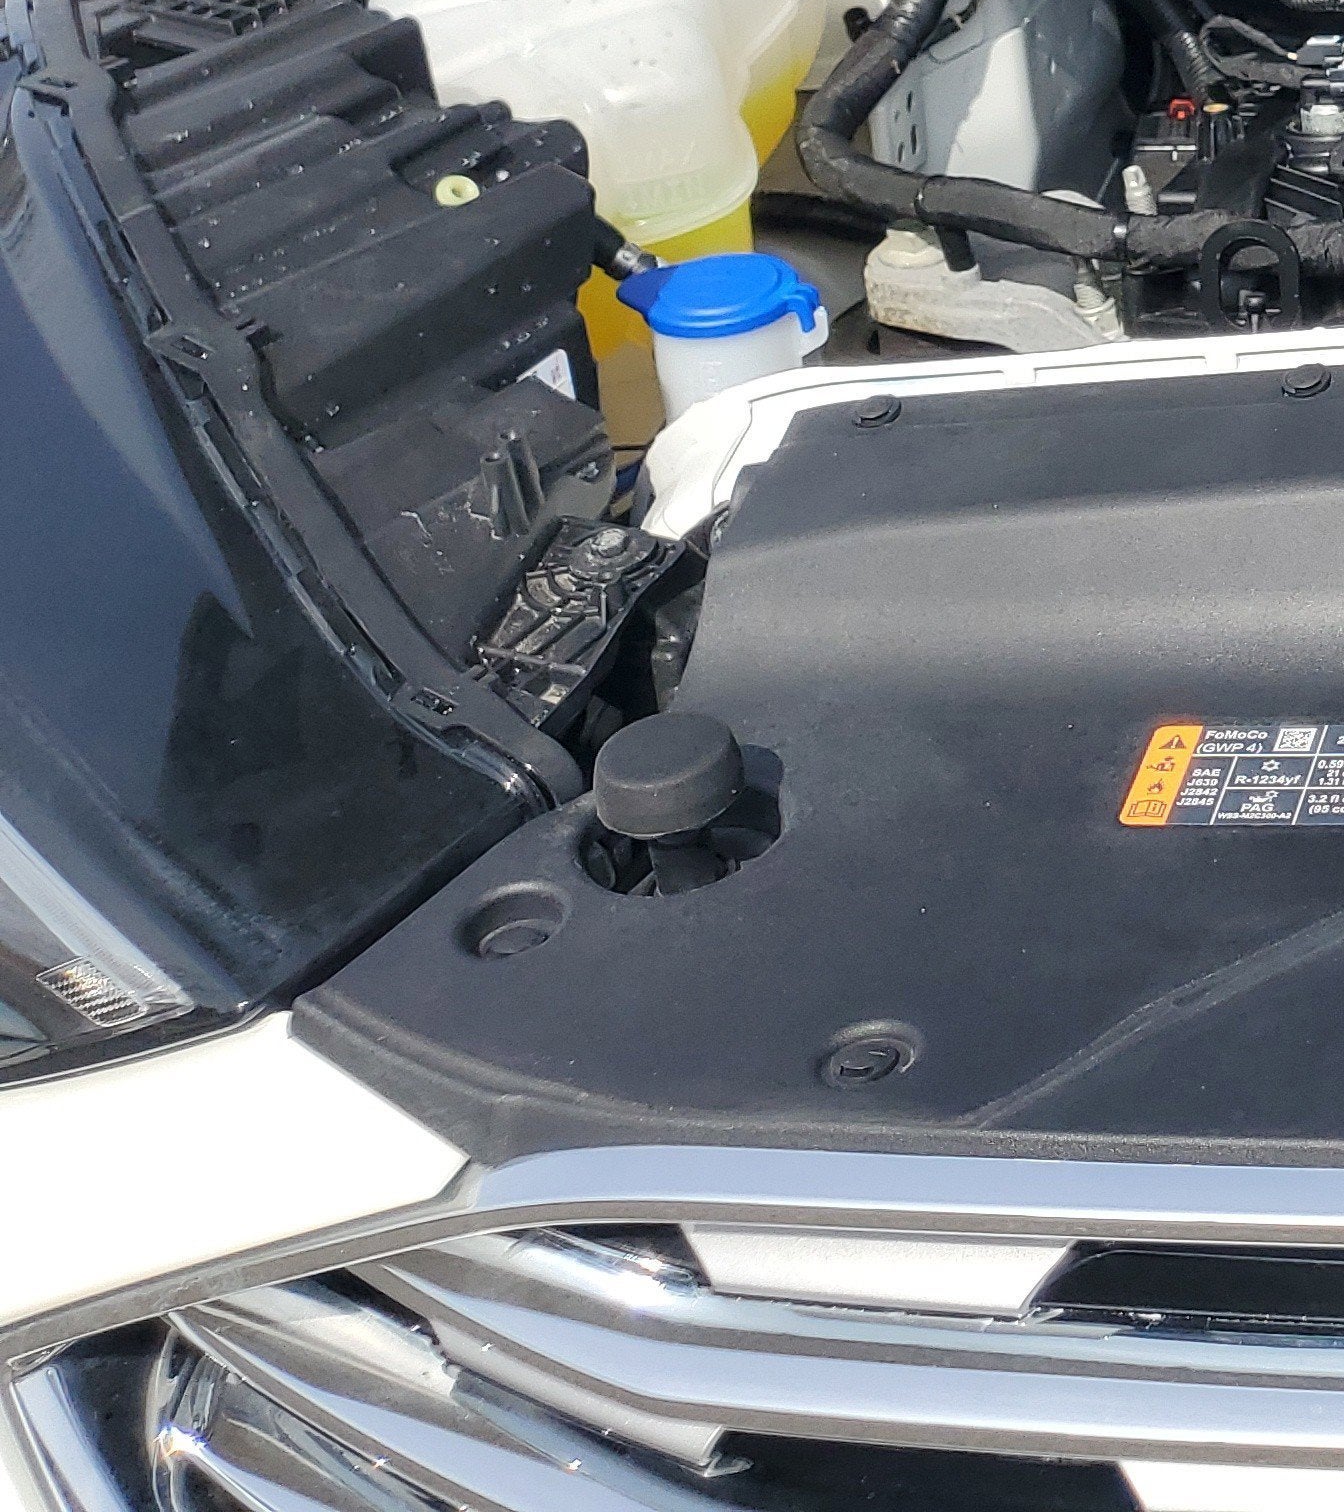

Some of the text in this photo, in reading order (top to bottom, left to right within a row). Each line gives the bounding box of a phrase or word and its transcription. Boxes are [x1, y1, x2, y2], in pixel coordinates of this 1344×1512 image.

[1204, 729, 1268, 740] FoMoCo
[1196, 742, 1264, 754] (GWP 4)
[1191, 768, 1222, 777] SAE
[1326, 769, 1340, 777] 21
[1186, 778, 1219, 786] J639
[1234, 774, 1302, 786] R-1234yf
[1318, 777, 1340, 786] 1.31
[1180, 788, 1219, 796] J2842
[1175, 797, 1215, 806] J2845
[1307, 794, 1328, 804] 3.2
[1329, 794, 1340, 804] fl
[1240, 803, 1275, 813] PAG
[1308, 804, 1330, 815] (95
